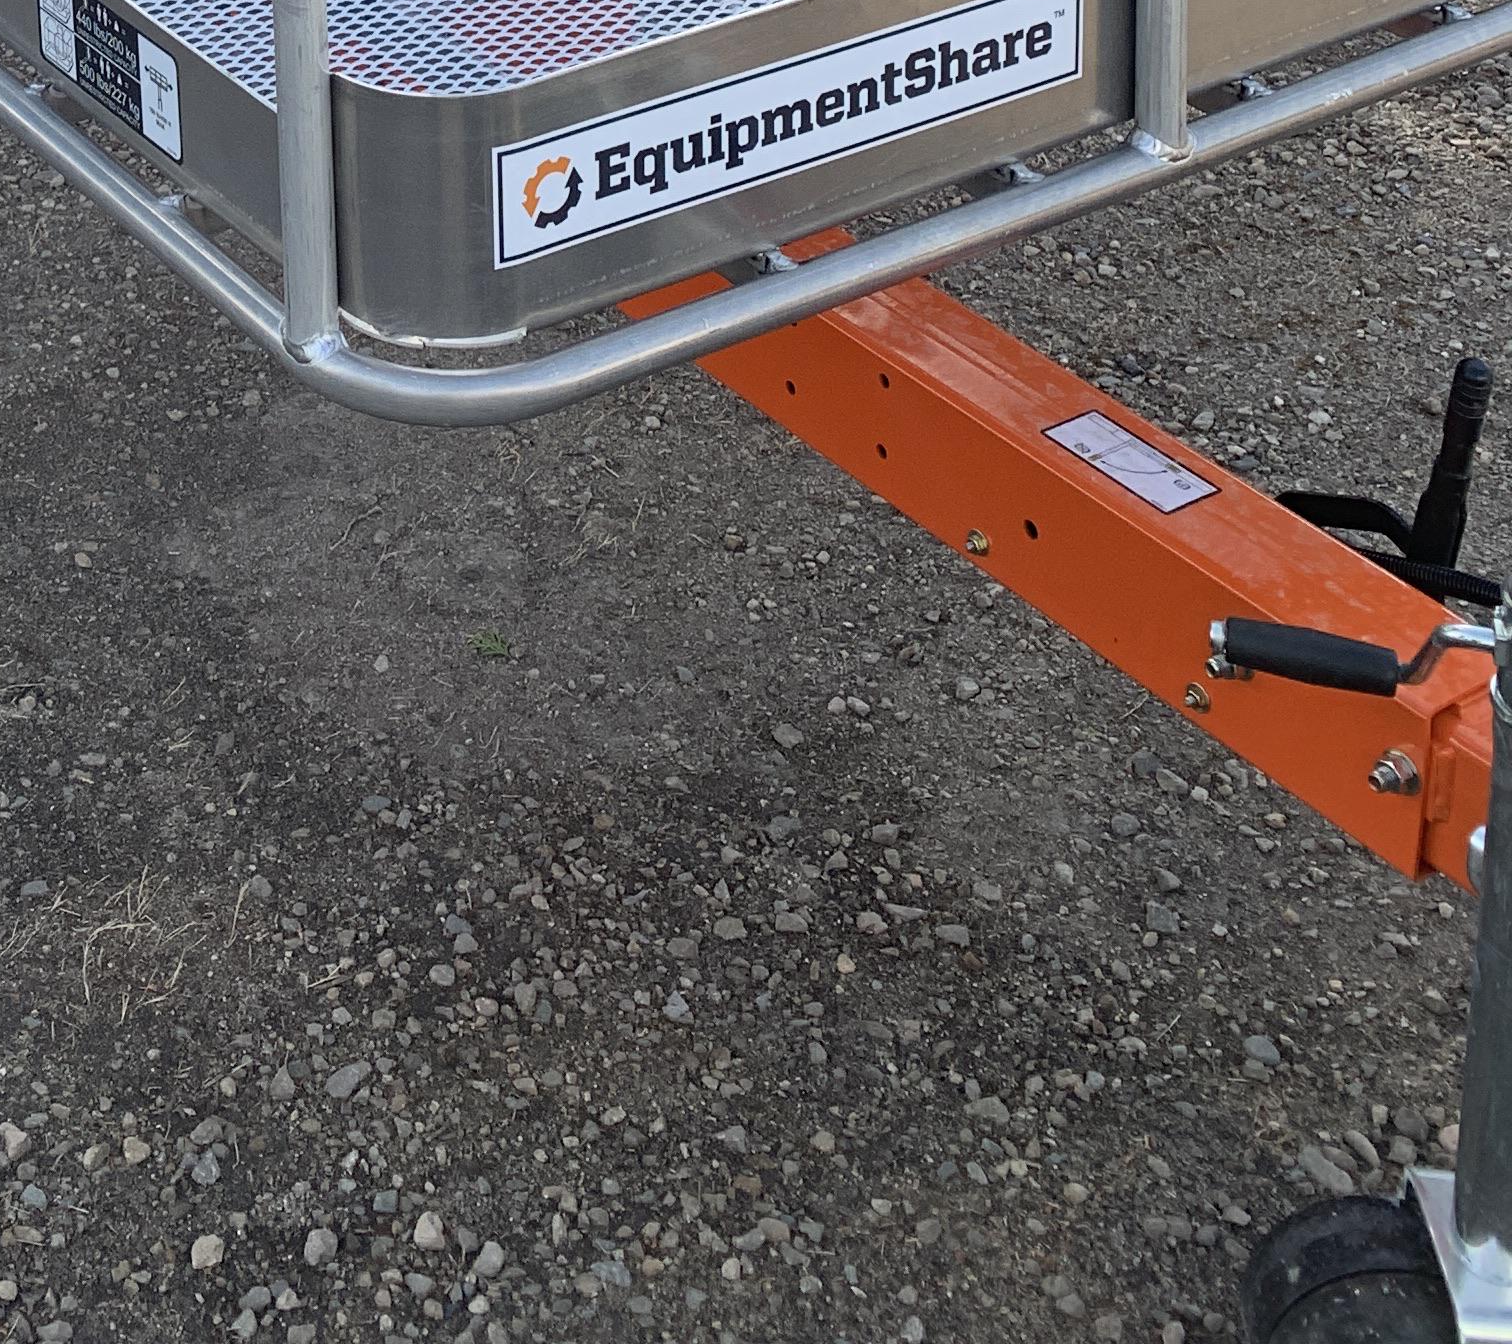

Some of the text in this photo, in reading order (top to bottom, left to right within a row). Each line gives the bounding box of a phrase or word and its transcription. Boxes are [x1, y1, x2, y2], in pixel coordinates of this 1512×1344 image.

[75, 9, 138, 69] 440 lbs/200 kg
[79, 59, 140, 121] 500 lbs/227 kg
[595, 19, 1053, 201] EquipmentShare
